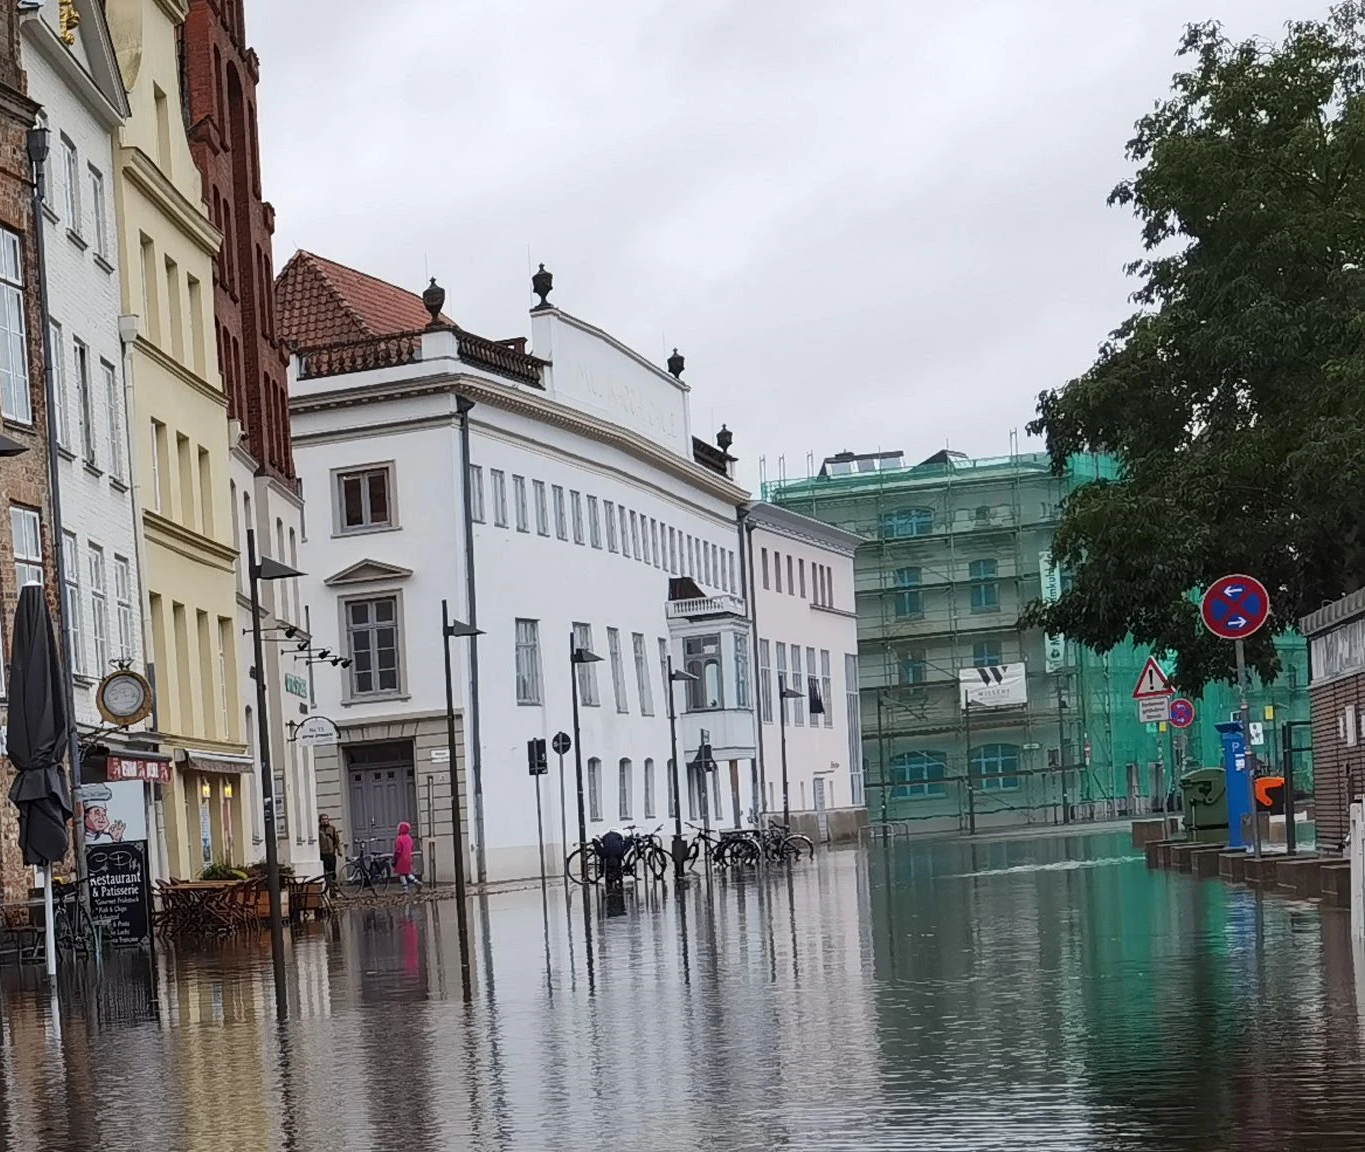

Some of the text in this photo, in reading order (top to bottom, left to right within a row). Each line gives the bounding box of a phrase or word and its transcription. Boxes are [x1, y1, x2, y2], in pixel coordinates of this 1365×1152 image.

[89, 872, 141, 886] Restaurant
[92, 884, 139, 897] & Patisserie
